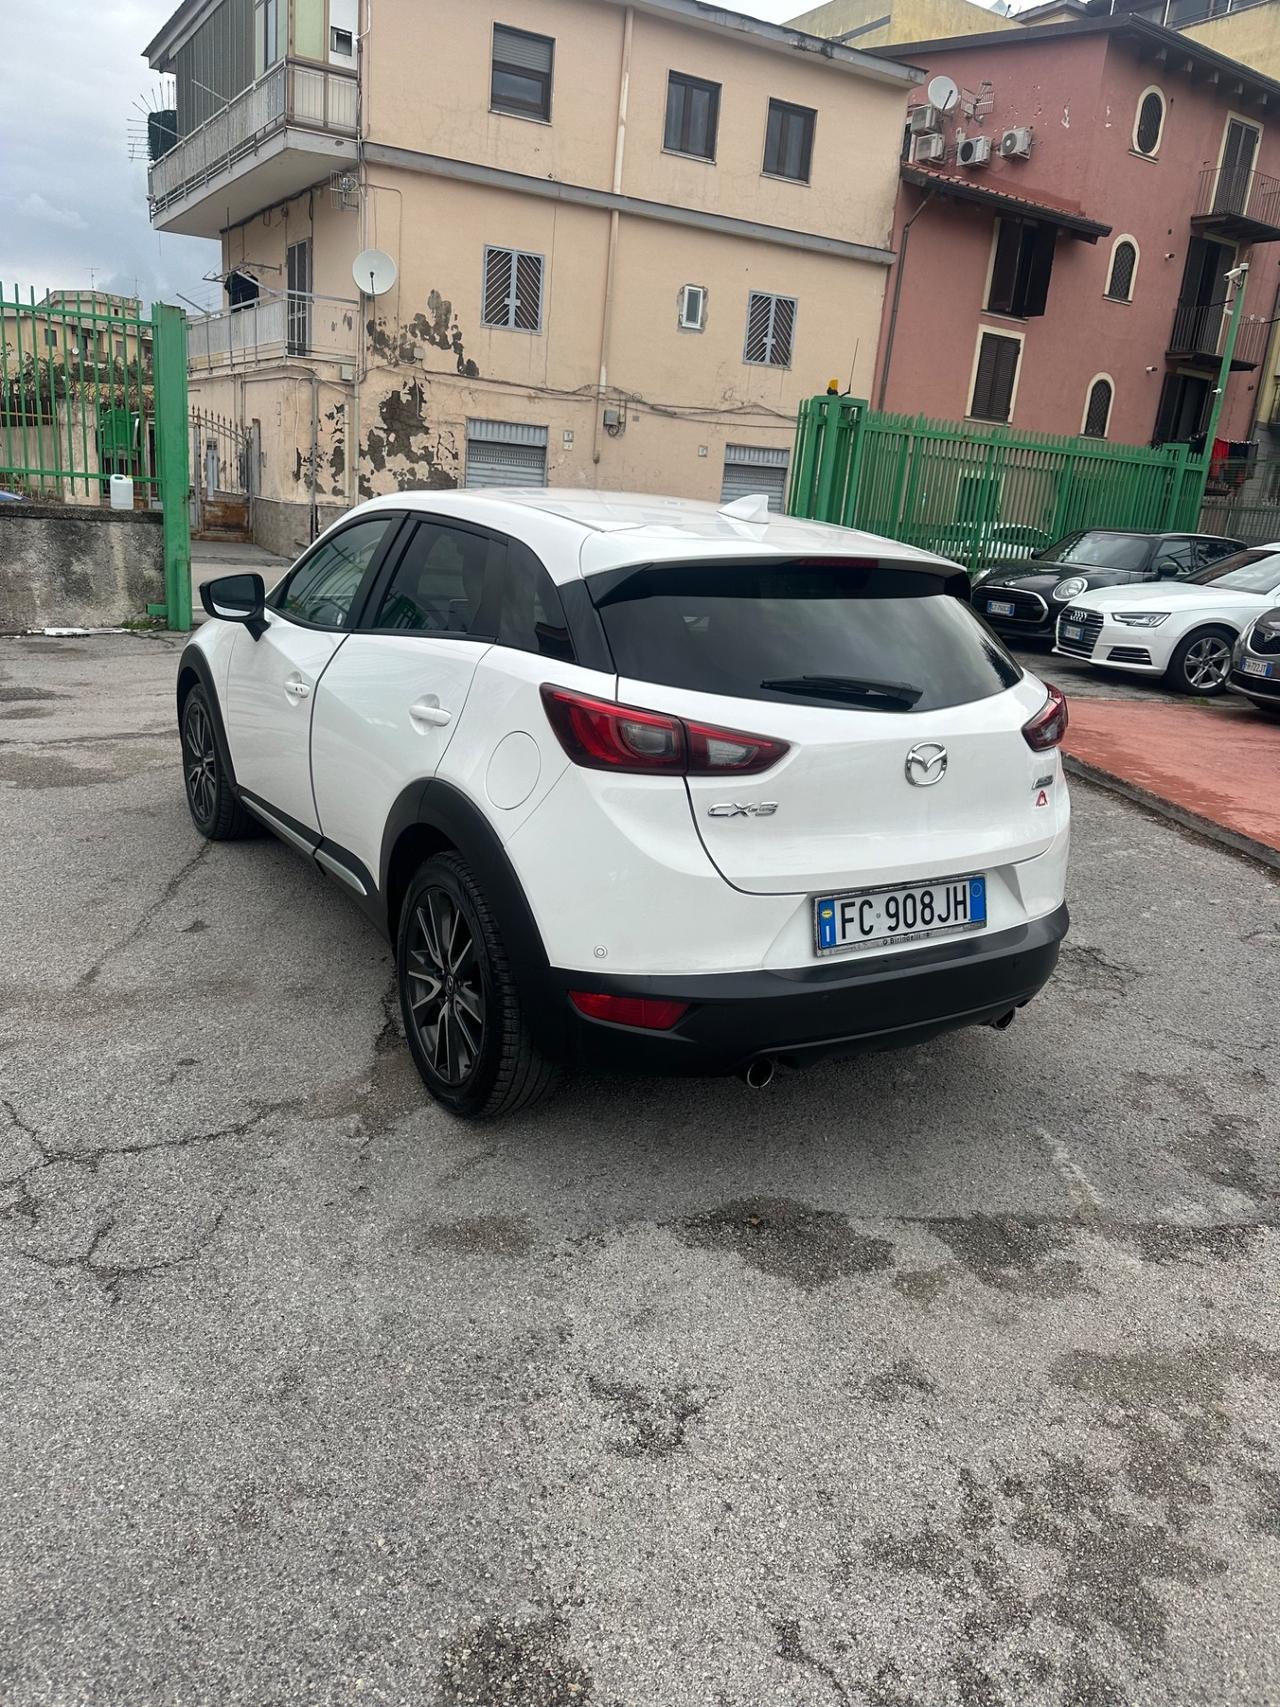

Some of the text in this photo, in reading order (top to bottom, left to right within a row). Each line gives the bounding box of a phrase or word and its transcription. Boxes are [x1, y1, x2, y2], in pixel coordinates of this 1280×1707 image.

[708, 801, 778, 817] CX-3
[841, 885, 967, 939] FC 908JH
